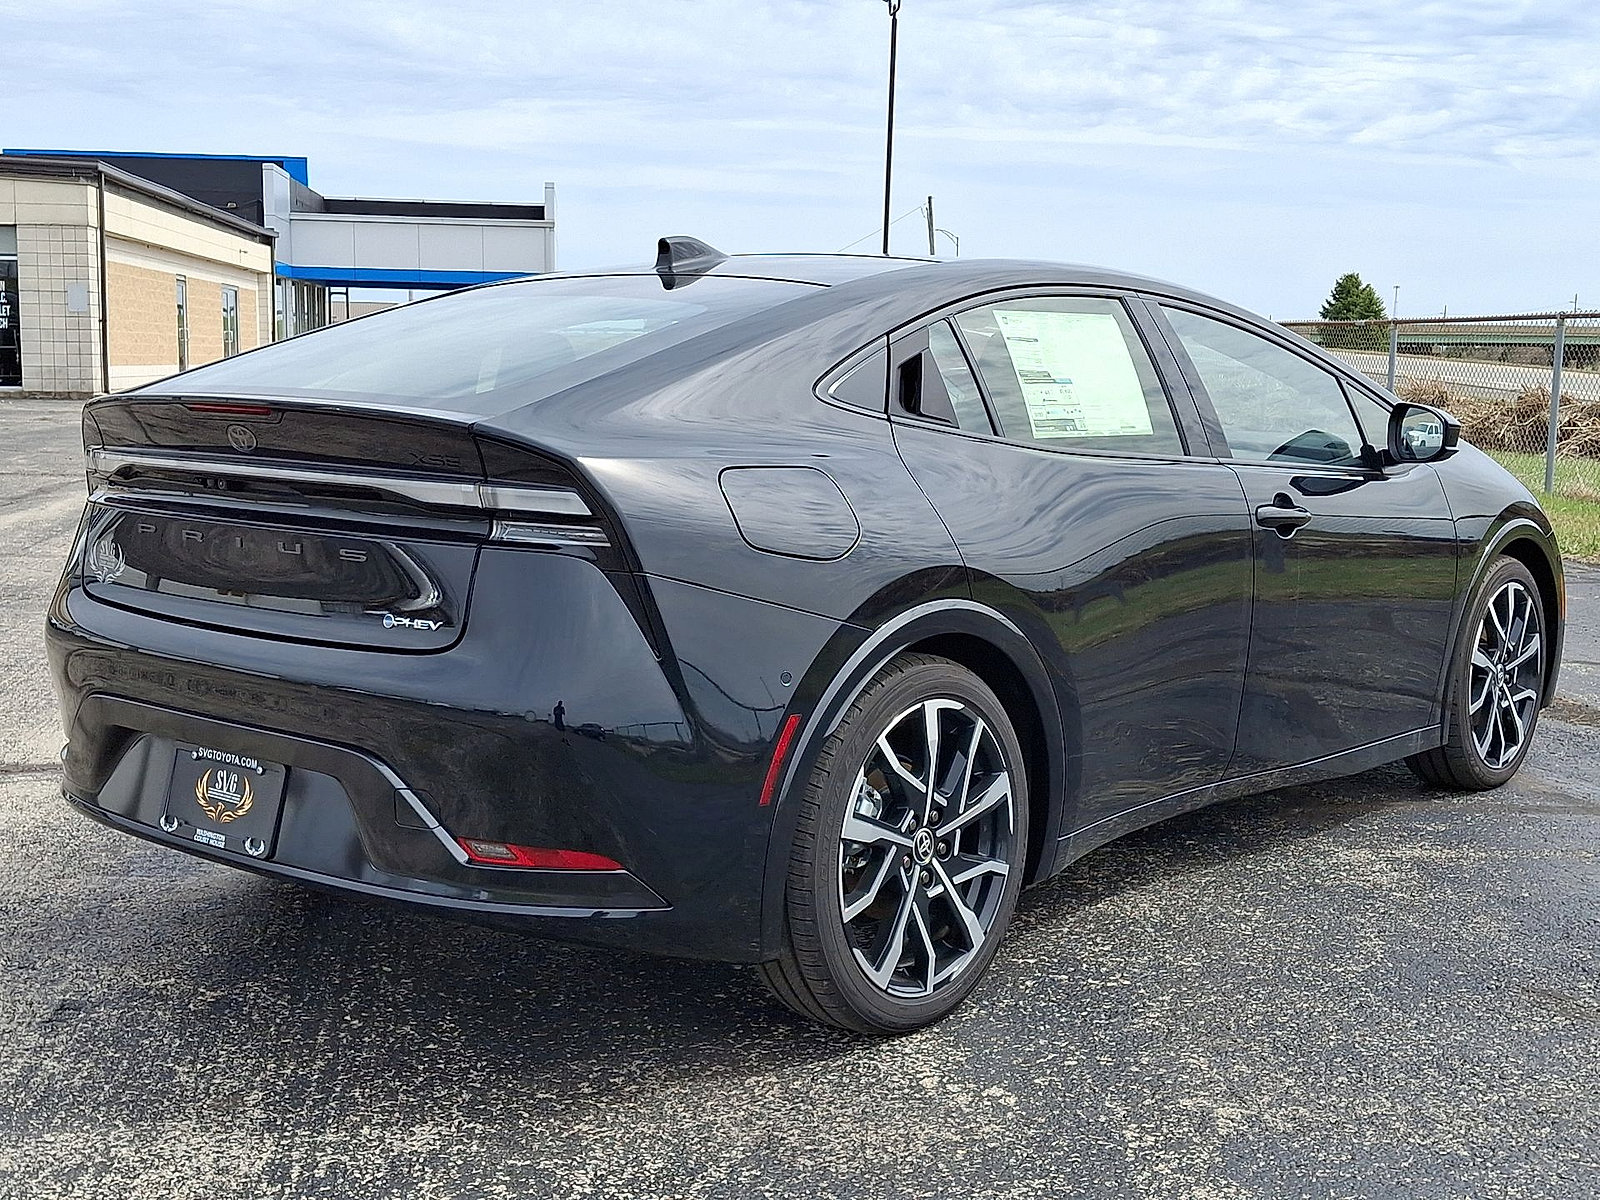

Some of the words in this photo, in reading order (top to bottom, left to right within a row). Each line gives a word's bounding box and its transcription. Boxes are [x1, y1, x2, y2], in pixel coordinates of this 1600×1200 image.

[409, 451, 461, 469] XSE
[137, 522, 368, 563] PRIUS
[393, 616, 444, 631] PHEV
[198, 747, 258, 769] SVGTOYOTA.COM
[215, 770, 238, 793] SVG
